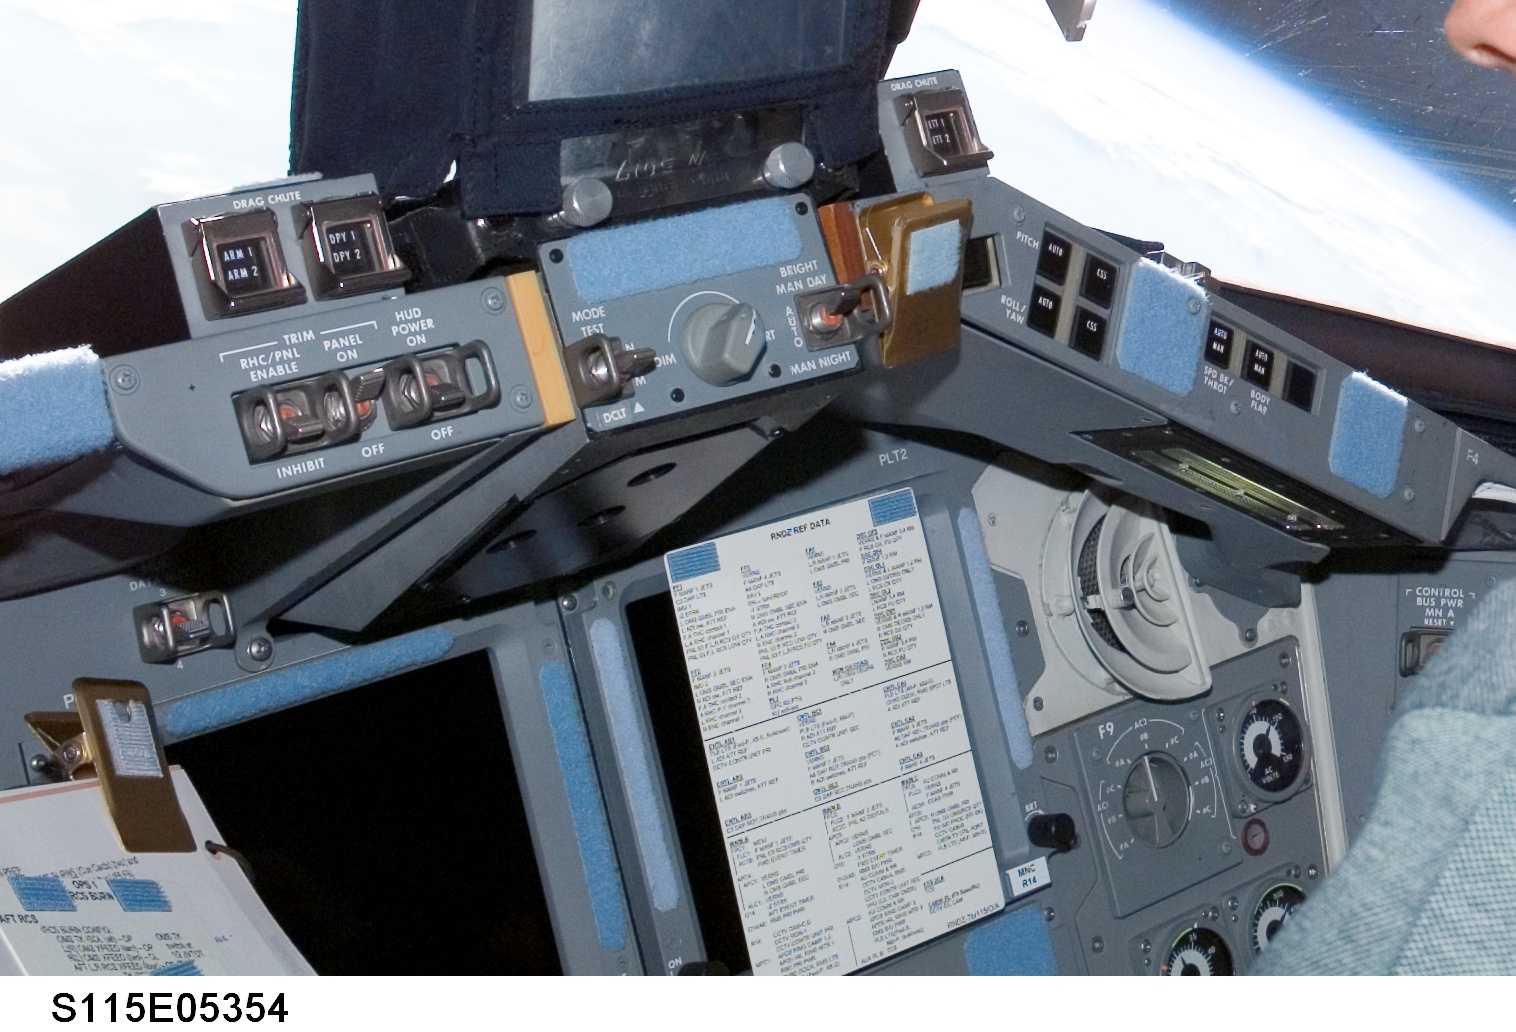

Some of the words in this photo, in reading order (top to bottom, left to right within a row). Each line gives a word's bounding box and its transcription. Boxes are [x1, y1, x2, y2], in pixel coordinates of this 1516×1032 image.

[891, 81, 913, 92] DRAG
[914, 76, 939, 88] CHUTE
[232, 196, 265, 210] DRAG
[267, 190, 302, 205] CHUTE
[1016, 230, 1040, 250] PITCH
[223, 247, 244, 262] ARM
[354, 248, 361, 260] 2
[228, 267, 249, 281] ARM
[251, 265, 258, 277] 2
[776, 280, 804, 295] MAN
[807, 274, 827, 288] DAY
[395, 307, 422, 322] HUD
[571, 306, 606, 323] MODE
[1005, 308, 1025, 325] YAW
[391, 318, 435, 337] POWER
[581, 323, 604, 338] TEST
[283, 329, 316, 346] TRIM
[322, 333, 363, 352] PANEL
[406, 333, 427, 347] ON
[239, 347, 301, 370] RHC/PNL
[336, 348, 358, 362] ON
[653, 353, 677, 368] DIM
[790, 359, 817, 376] MAN
[819, 351, 851, 368] NIGHT
[250, 362, 299, 382] ENABLE
[1250, 389, 1271, 405] BODY
[602, 408, 627, 424] DCLT
[430, 426, 454, 440] OFF
[361, 443, 385, 458] OFF
[879, 448, 908, 467] PLT2
[276, 457, 325, 479] INHIBIT
[793, 523, 809, 535] REF
[810, 518, 831, 530] DATA
[1415, 586, 1465, 598] CONTROL
[1416, 597, 1436, 607] BUS
[1440, 598, 1464, 608] PWR
[1425, 608, 1443, 618] MN
[1446, 609, 1455, 618] A
[1424, 618, 1447, 626] RESET
[176, 660, 184, 670] 4
[1098, 722, 1114, 739] F9
[1024, 801, 1038, 813] BRT
[1022, 875, 1037, 888] R14
[667, 956, 683, 969] ON
